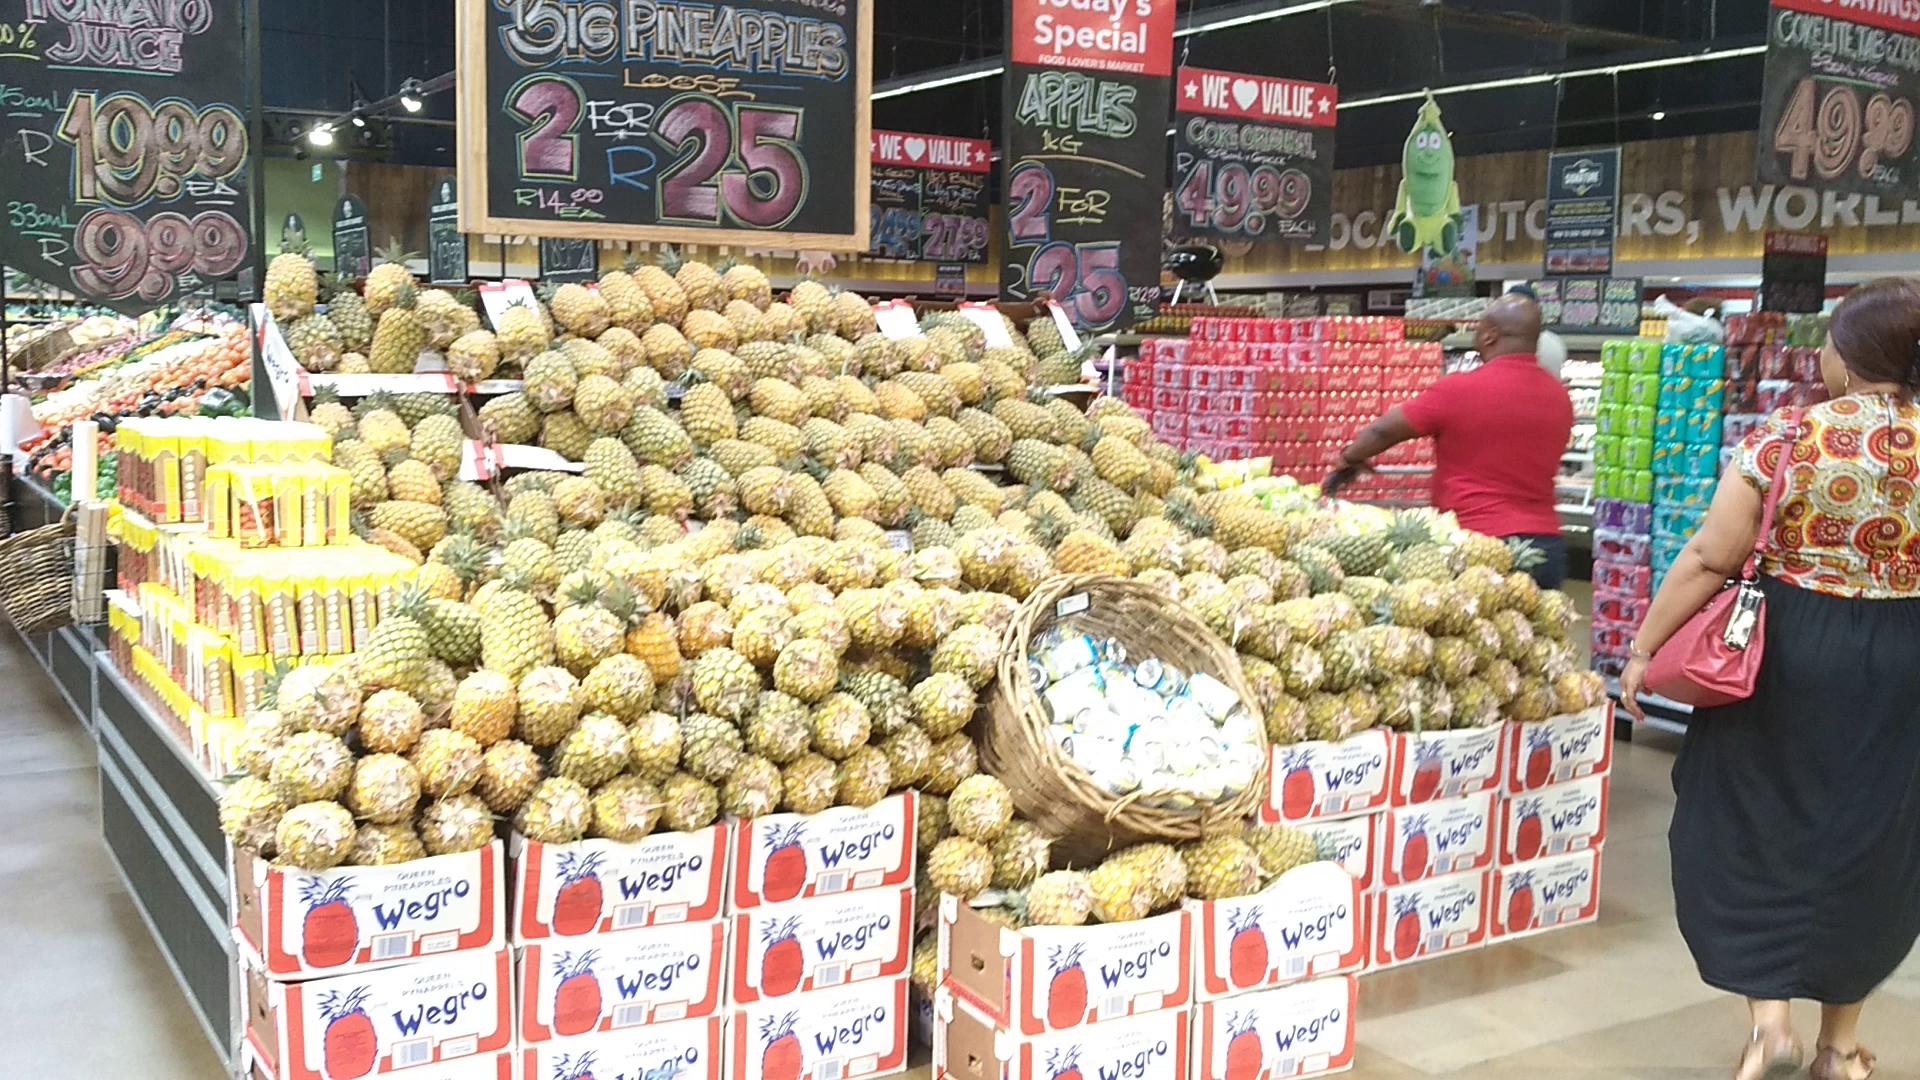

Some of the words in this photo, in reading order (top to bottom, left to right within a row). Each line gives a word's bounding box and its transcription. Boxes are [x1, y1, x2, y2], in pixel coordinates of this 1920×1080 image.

[1835, 0, 1920, 22] VINGS
[0, 23, 37, 48] 0%
[45, 22, 183, 72] JUICE
[499, 0, 619, 67] BIG
[622, 0, 849, 81] PINEAPPLES
[1034, 14, 1147, 54] Special
[623, 68, 756, 100] LOOSE
[1039, 54, 1065, 64] FOOD
[1107, 60, 1145, 72] MARKET
[587, 100, 656, 130] FOR
[1015, 71, 1137, 138] APPLES
[1202, 74, 1230, 109] WE
[1262, 81, 1315, 118] VALUE
[18, 130, 53, 167] R
[57, 89, 249, 209] 19.99
[503, 72, 587, 182] 2
[1774, 78, 1915, 181] 49.99
[605, 146, 657, 190] R
[649, 92, 810, 229] 25
[879, 133, 902, 161] WE
[928, 139, 972, 167] VALUE
[187, 180, 239, 196] EA
[1008, 160, 1055, 248] 2
[1056, 187, 1110, 215] FOR
[1176, 158, 1312, 236] 49.99
[37, 238, 70, 266] R
[69, 207, 248, 300] 9.99
[1026, 240, 1128, 331] 25
[1451, 740, 1495, 777] Wegro
[1560, 724, 1601, 760] Wegro
[1325, 754, 1381, 792] Wegro
[1436, 815, 1483, 852] Wegro
[1551, 796, 1597, 832] Wegro
[820, 824, 894, 868] Wegro
[1332, 836, 1361, 863] gro
[618, 855, 703, 901] Wegro
[1542, 868, 1589, 904] Wegro
[372, 879, 470, 931] Wegro
[1281, 904, 1346, 950] Wegro
[1429, 891, 1475, 929] Wegro
[816, 915, 890, 960] Wegro
[615, 953, 700, 1001] Wegro
[1100, 941, 1171, 989] Wegro
[392, 982, 487, 1037] Wegro
[814, 1006, 886, 1056] Wegro
[1276, 1008, 1340, 1051] Wegro
[1098, 1040, 1168, 1080] Wegro
